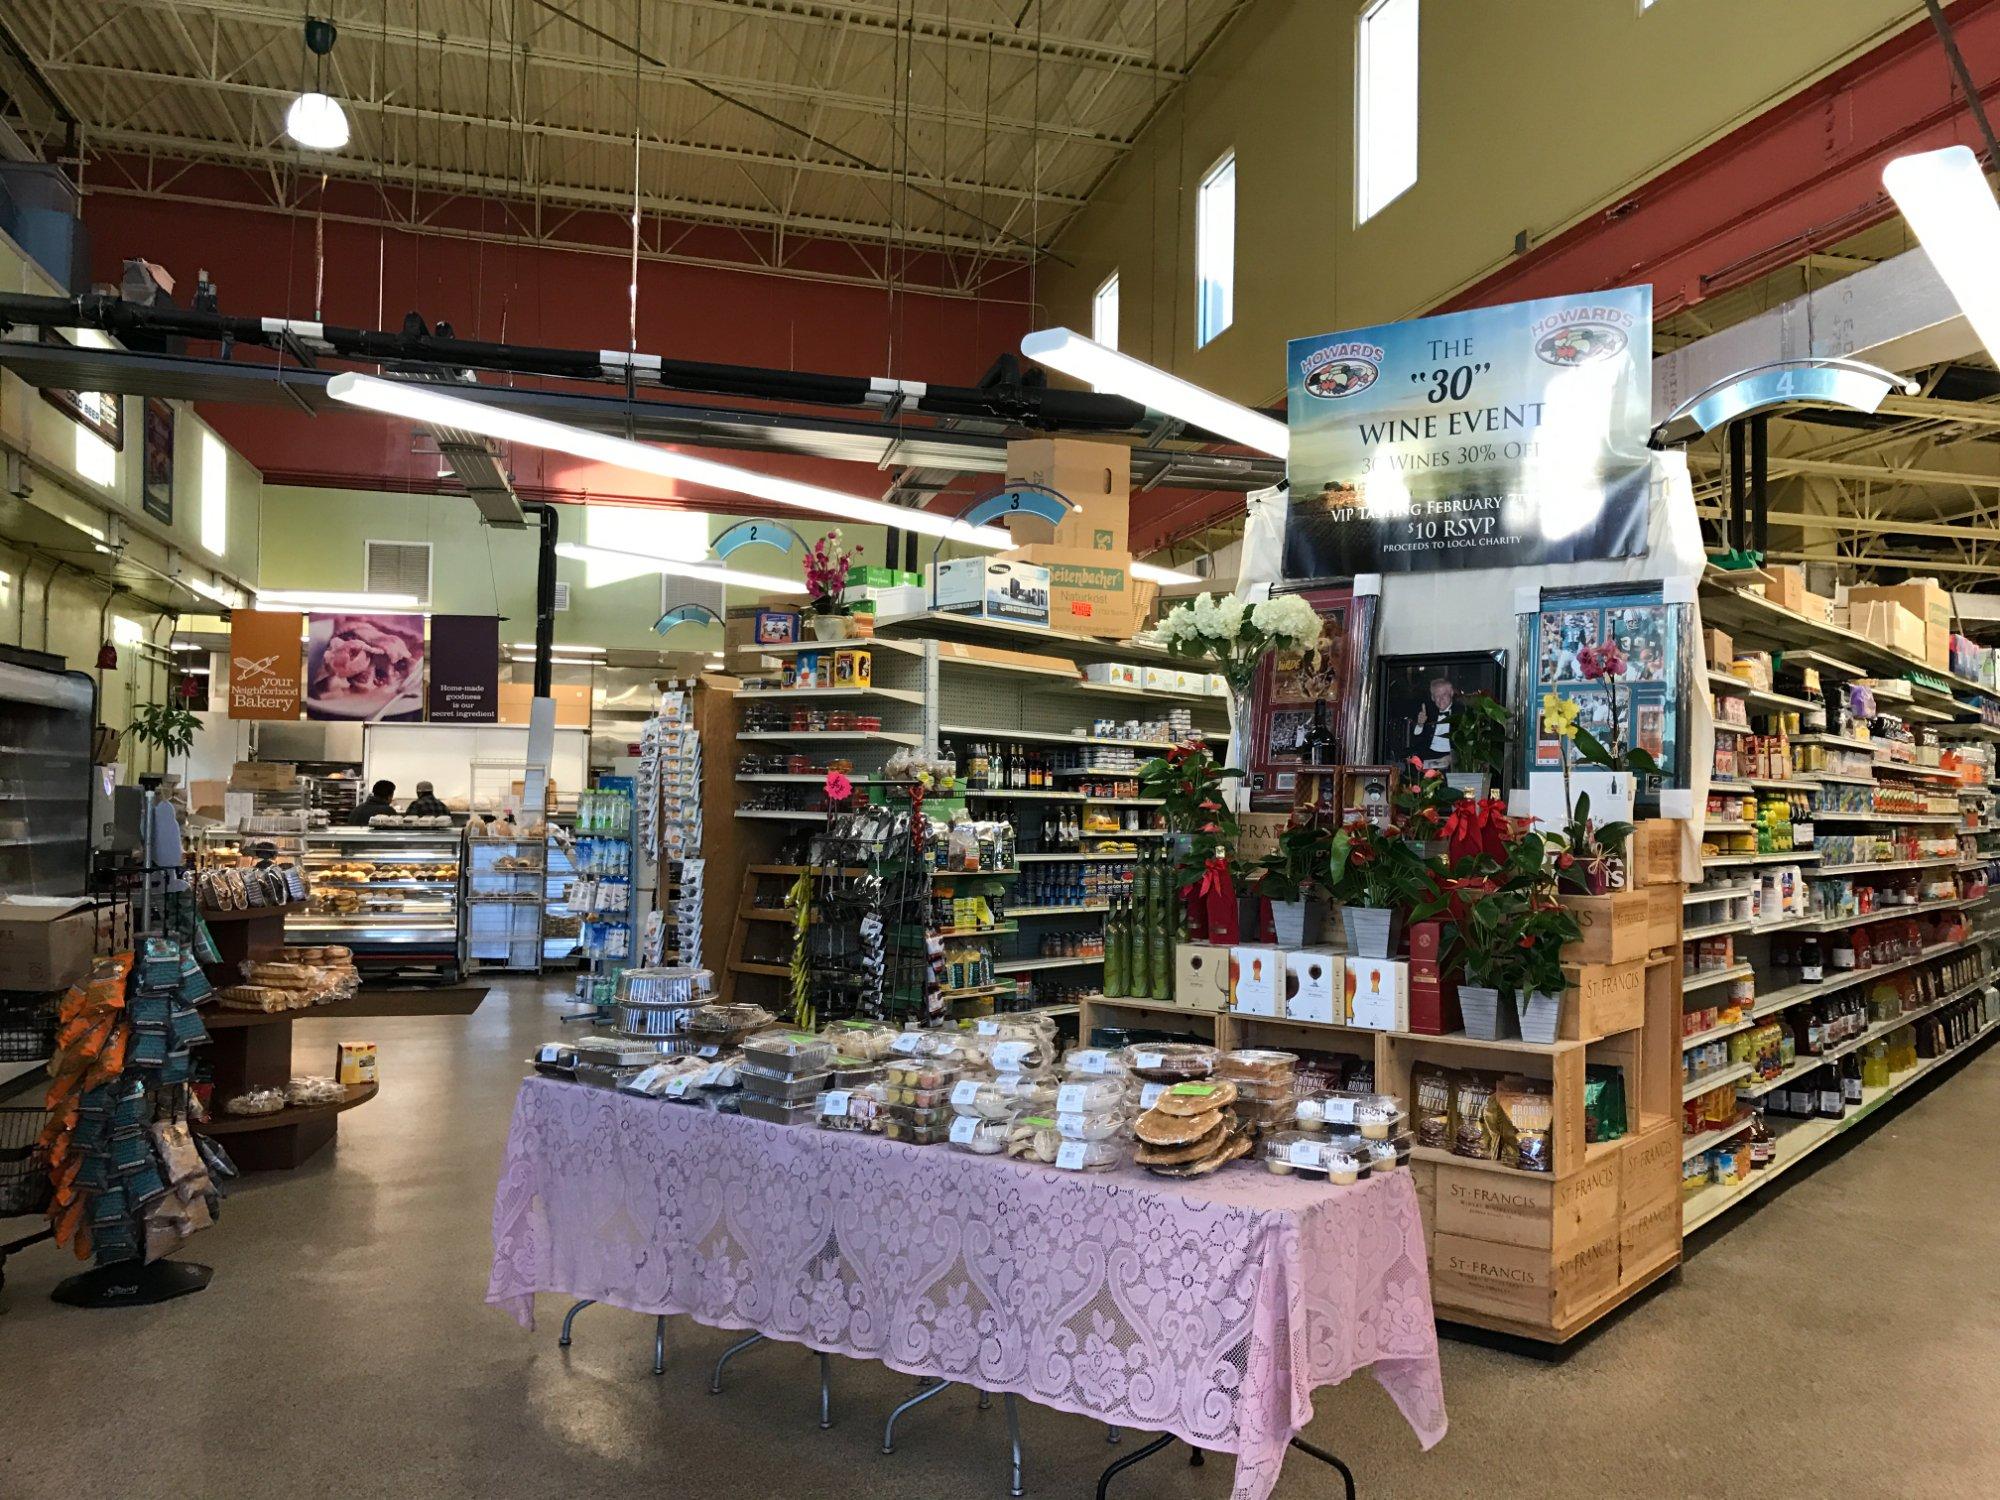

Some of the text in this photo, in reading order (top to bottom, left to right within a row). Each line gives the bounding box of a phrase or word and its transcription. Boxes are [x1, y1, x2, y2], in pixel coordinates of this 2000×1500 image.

[1531, 307, 1634, 337] HOWARDS
[1301, 343, 1384, 373] HOWARDS
[1427, 337, 1474, 361] THE
[1776, 371, 1795, 396] 4
[1359, 402, 1546, 446] WINE EVENT
[1388, 450, 1450, 472] WINES
[1457, 443, 1497, 465] 30%
[1010, 493, 1020, 510] 3
[1331, 508, 1354, 523] VIP
[1427, 496, 1503, 515] FEBRUARY
[750, 526, 757, 541] 2
[1408, 517, 1496, 540] $10 RSVP
[1383, 535, 1522, 553] PROCEEDS TO LOCAL CHARITY
[231, 685, 299, 696] Neighborhood
[262, 678, 294, 688] your
[440, 684, 485, 692] Home-made
[234, 694, 294, 712] Bakery
[456, 710, 495, 719] ingredient
[1602, 971, 1640, 996] FRANCIS
[1474, 1188, 1536, 1209] FRANCIS
[1472, 1261, 1535, 1284] FRANCIS
